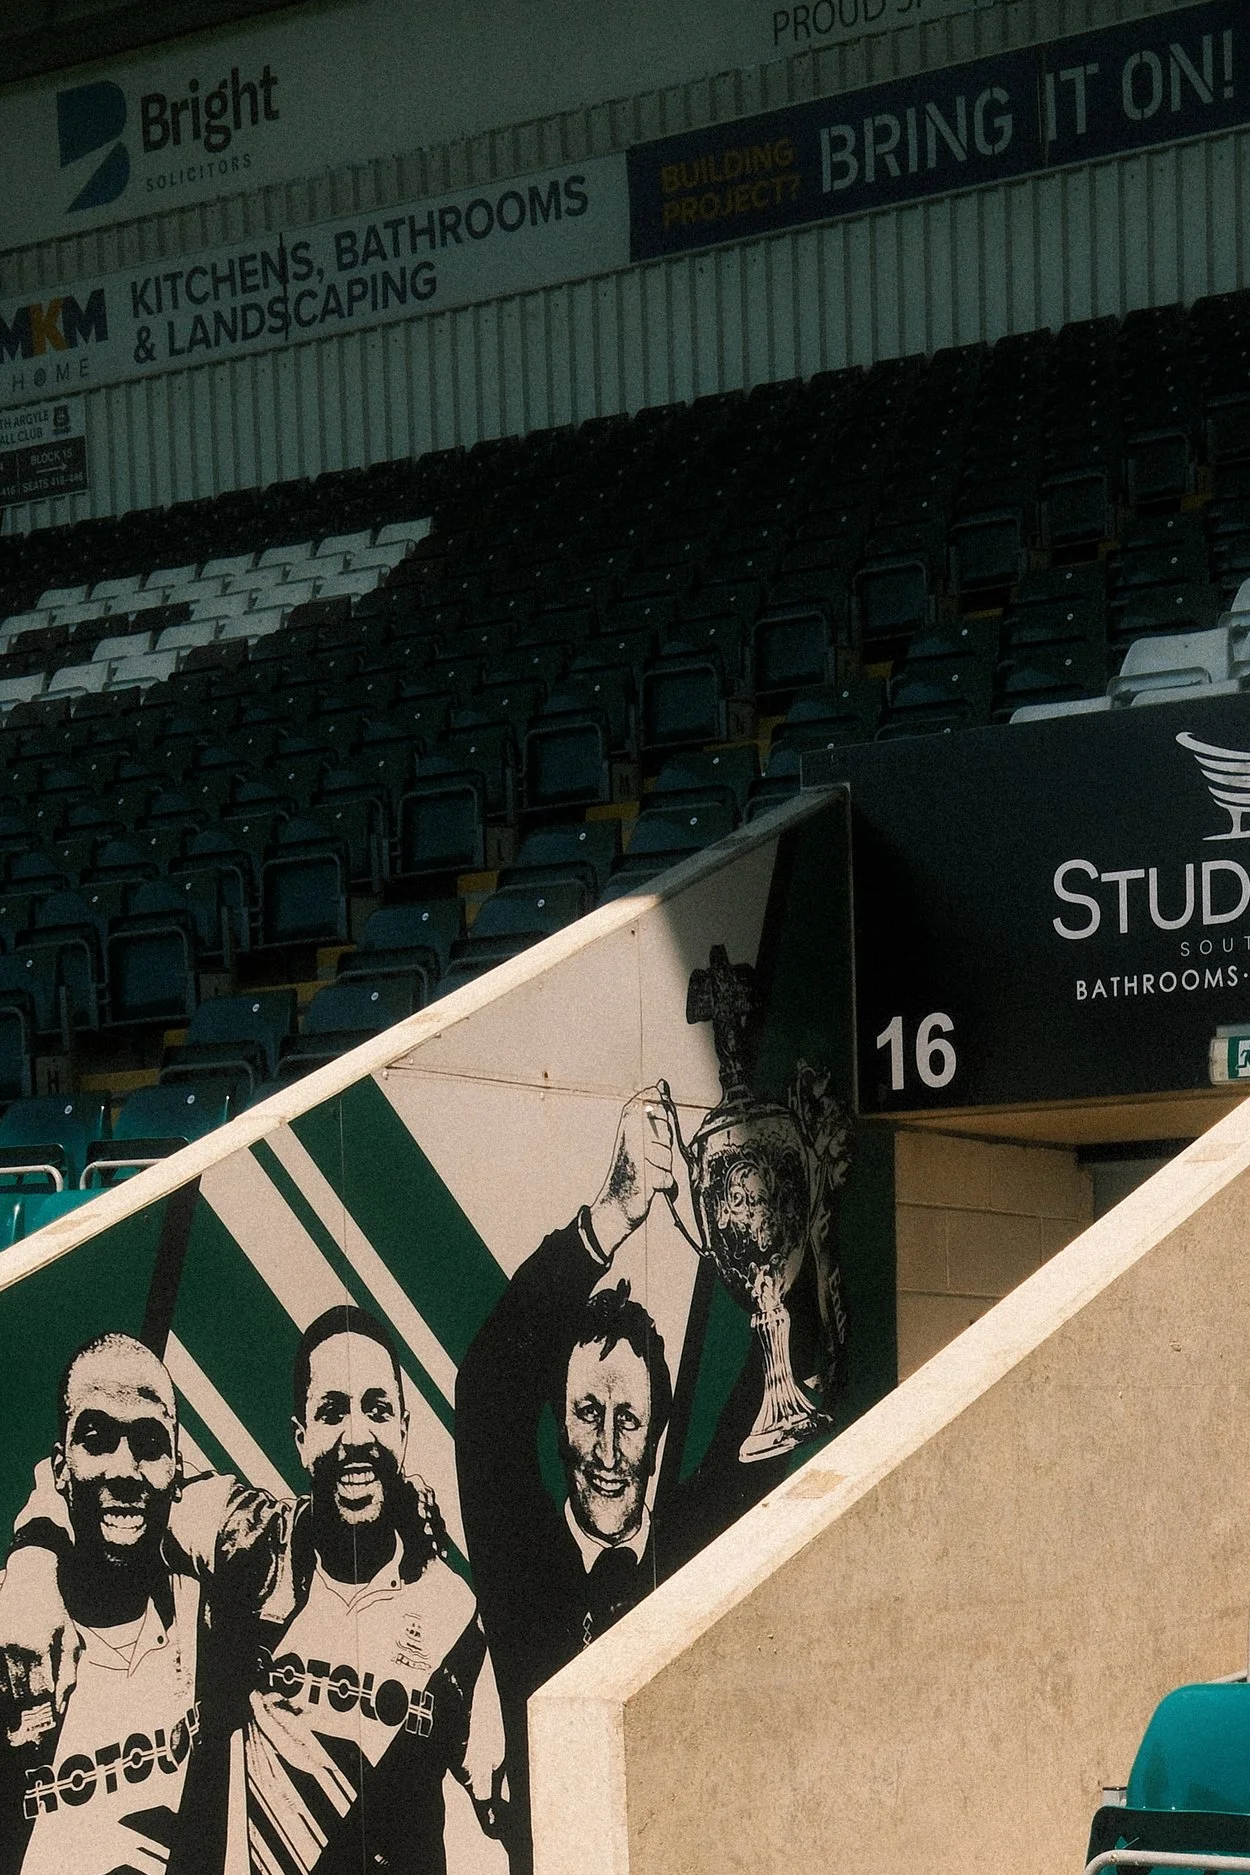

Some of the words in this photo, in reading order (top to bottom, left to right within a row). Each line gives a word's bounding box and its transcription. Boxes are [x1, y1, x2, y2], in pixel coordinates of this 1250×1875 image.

[772, 0, 886, 46] PROUD
[140, 64, 280, 154] Bright
[820, 86, 1013, 194] BRING
[1046, 62, 1100, 141] IT
[1122, 29, 1233, 121] ON!
[146, 153, 252, 192] SOLICITORS
[661, 137, 794, 194] BUILDING
[662, 172, 801, 230] PROJECT?
[131, 241, 325, 319] KITCHENS,
[334, 174, 589, 273] BATHROOMS
[0, 288, 109, 364] MKM
[134, 326, 157, 365] &
[168, 261, 437, 357] LANDSCAPING
[13, 410, 49, 427] ARGYLE
[17, 427, 43, 441] CLUB
[30, 450, 61, 465] BLOCK
[876, 1012, 957, 1091] 16
